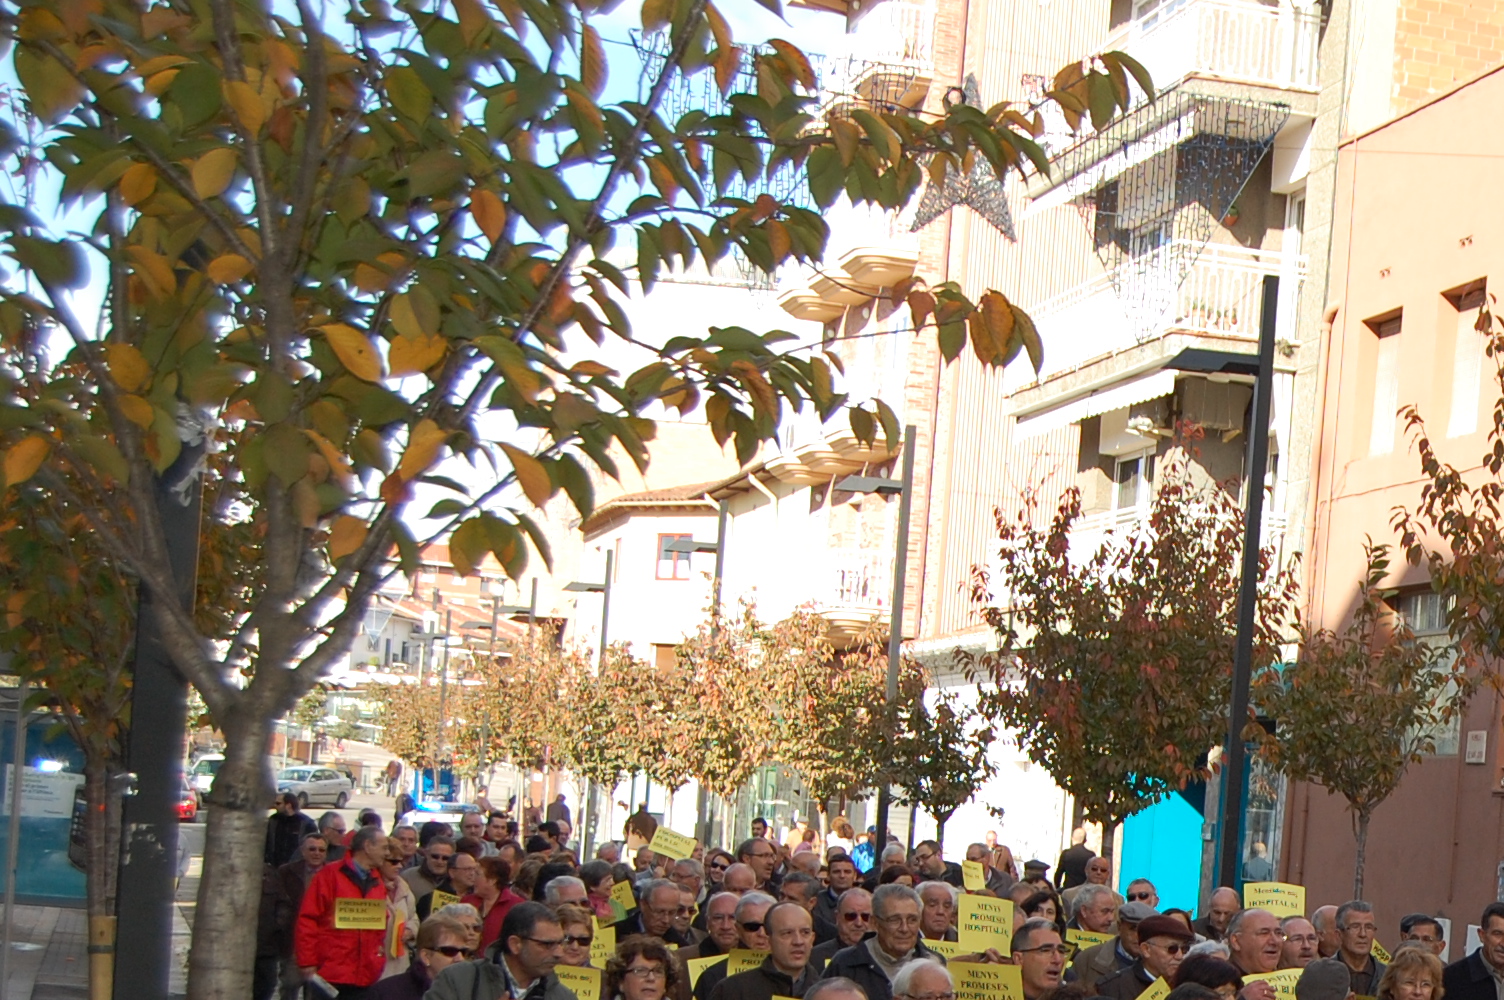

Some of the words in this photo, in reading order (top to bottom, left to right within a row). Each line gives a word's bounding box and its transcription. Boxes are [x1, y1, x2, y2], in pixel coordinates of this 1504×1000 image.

[977, 903, 1001, 912] MENYS
[1249, 899, 1289, 907] HOSPITAL
[970, 914, 1006, 924] PROMESES
[967, 970, 999, 980] MENYS
[961, 980, 1009, 991] PROMESES
